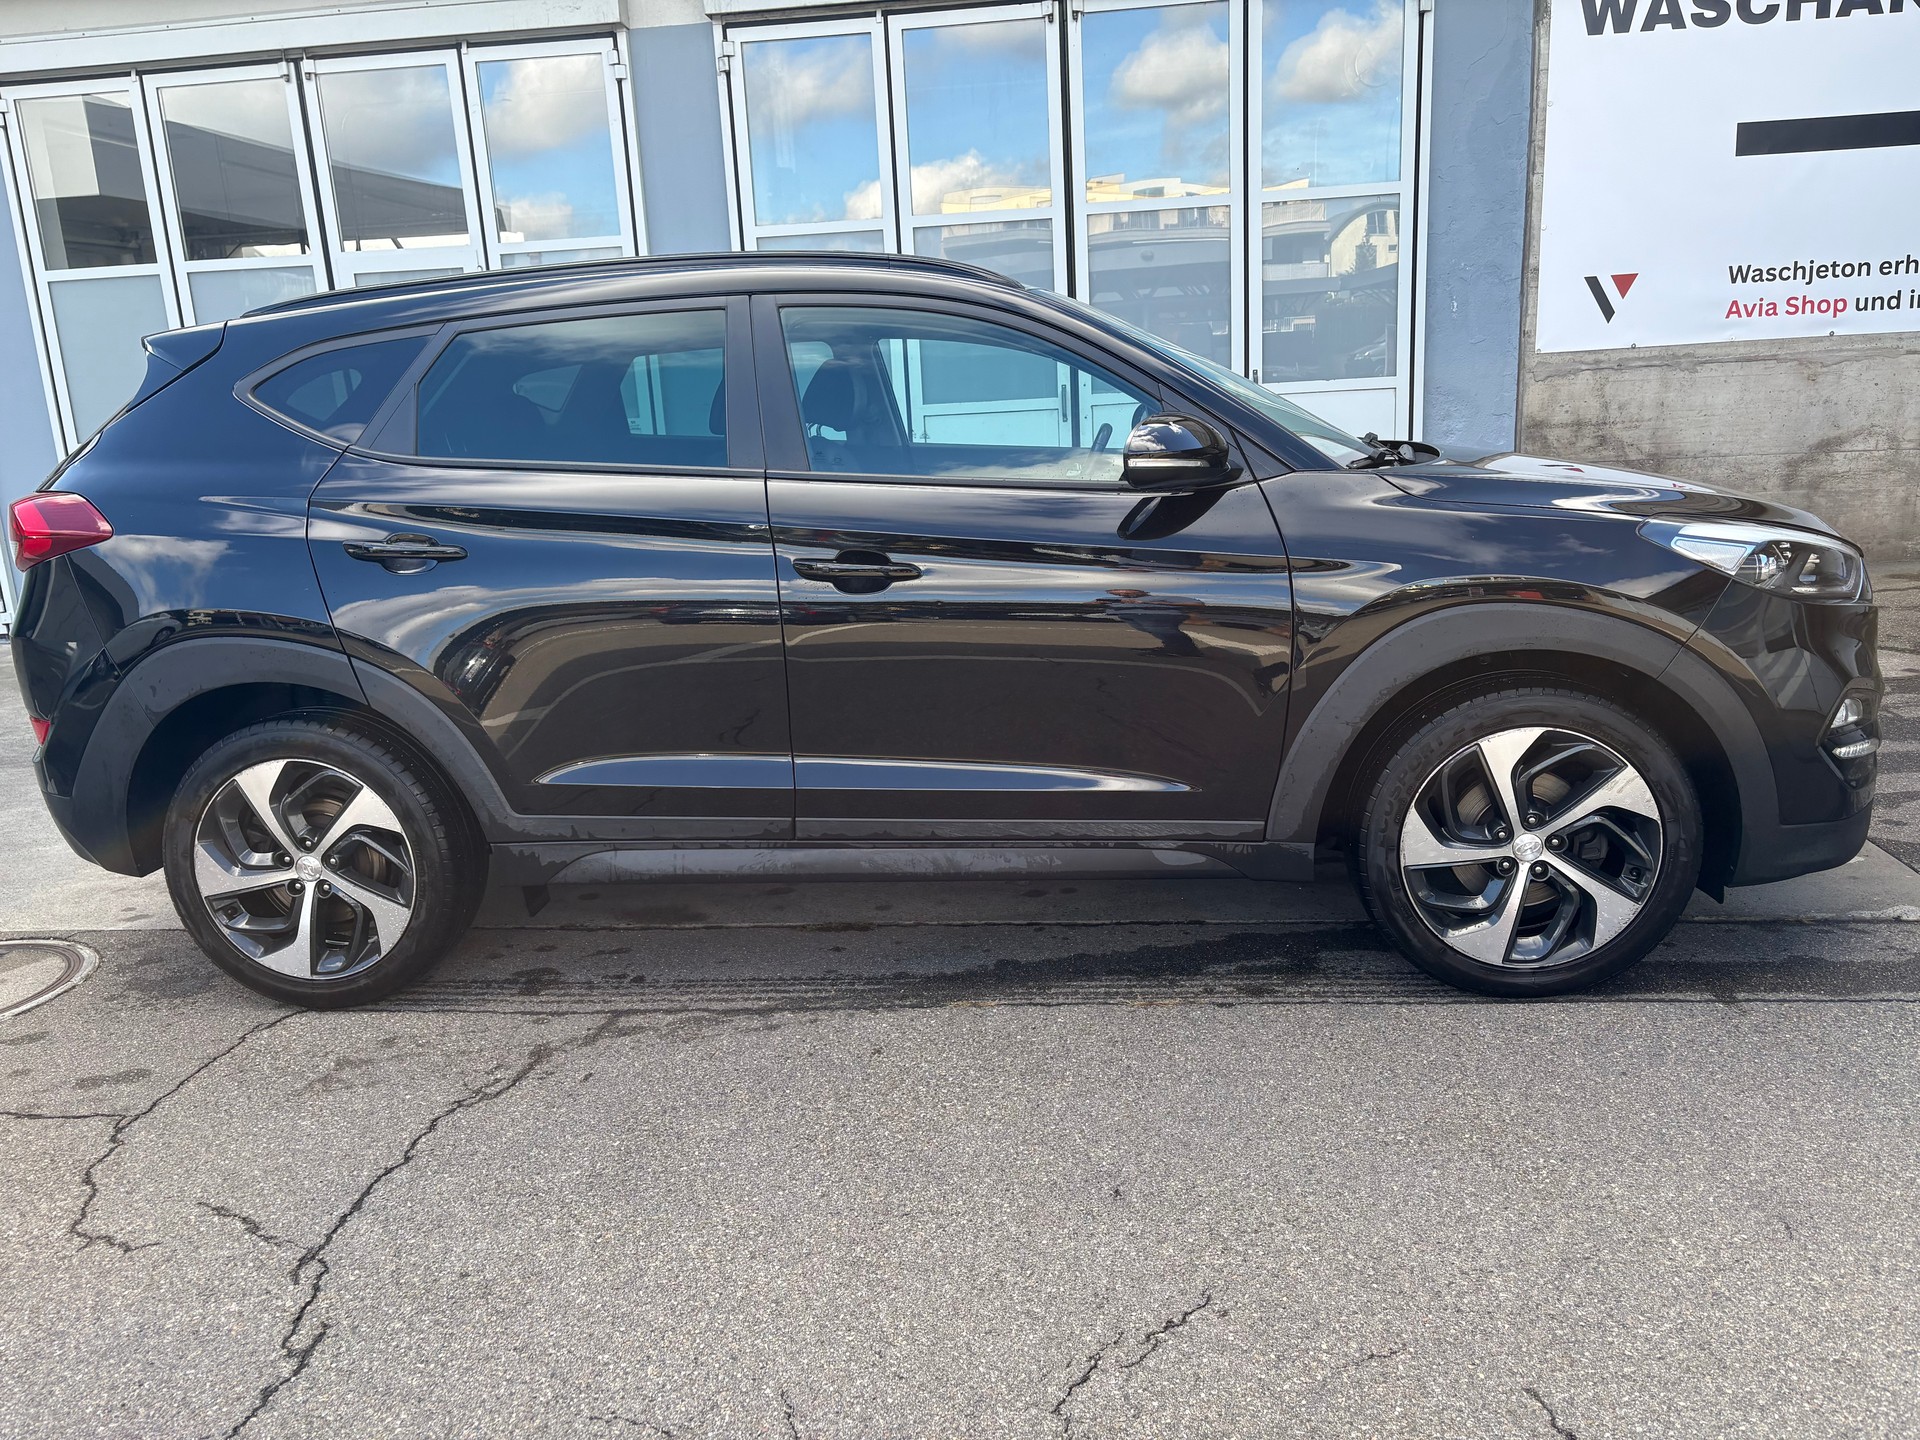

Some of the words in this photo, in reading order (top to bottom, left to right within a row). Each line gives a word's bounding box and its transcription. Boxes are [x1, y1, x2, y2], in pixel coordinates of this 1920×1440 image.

[1581, 0, 1920, 36] WASC
[1728, 259, 1871, 286] Waschjeton
[1879, 253, 1920, 276] erh
[1725, 297, 1779, 319] Avia
[1784, 294, 1849, 318] Shop
[1855, 289, 1902, 312] und
[1909, 288, 1920, 309] i
